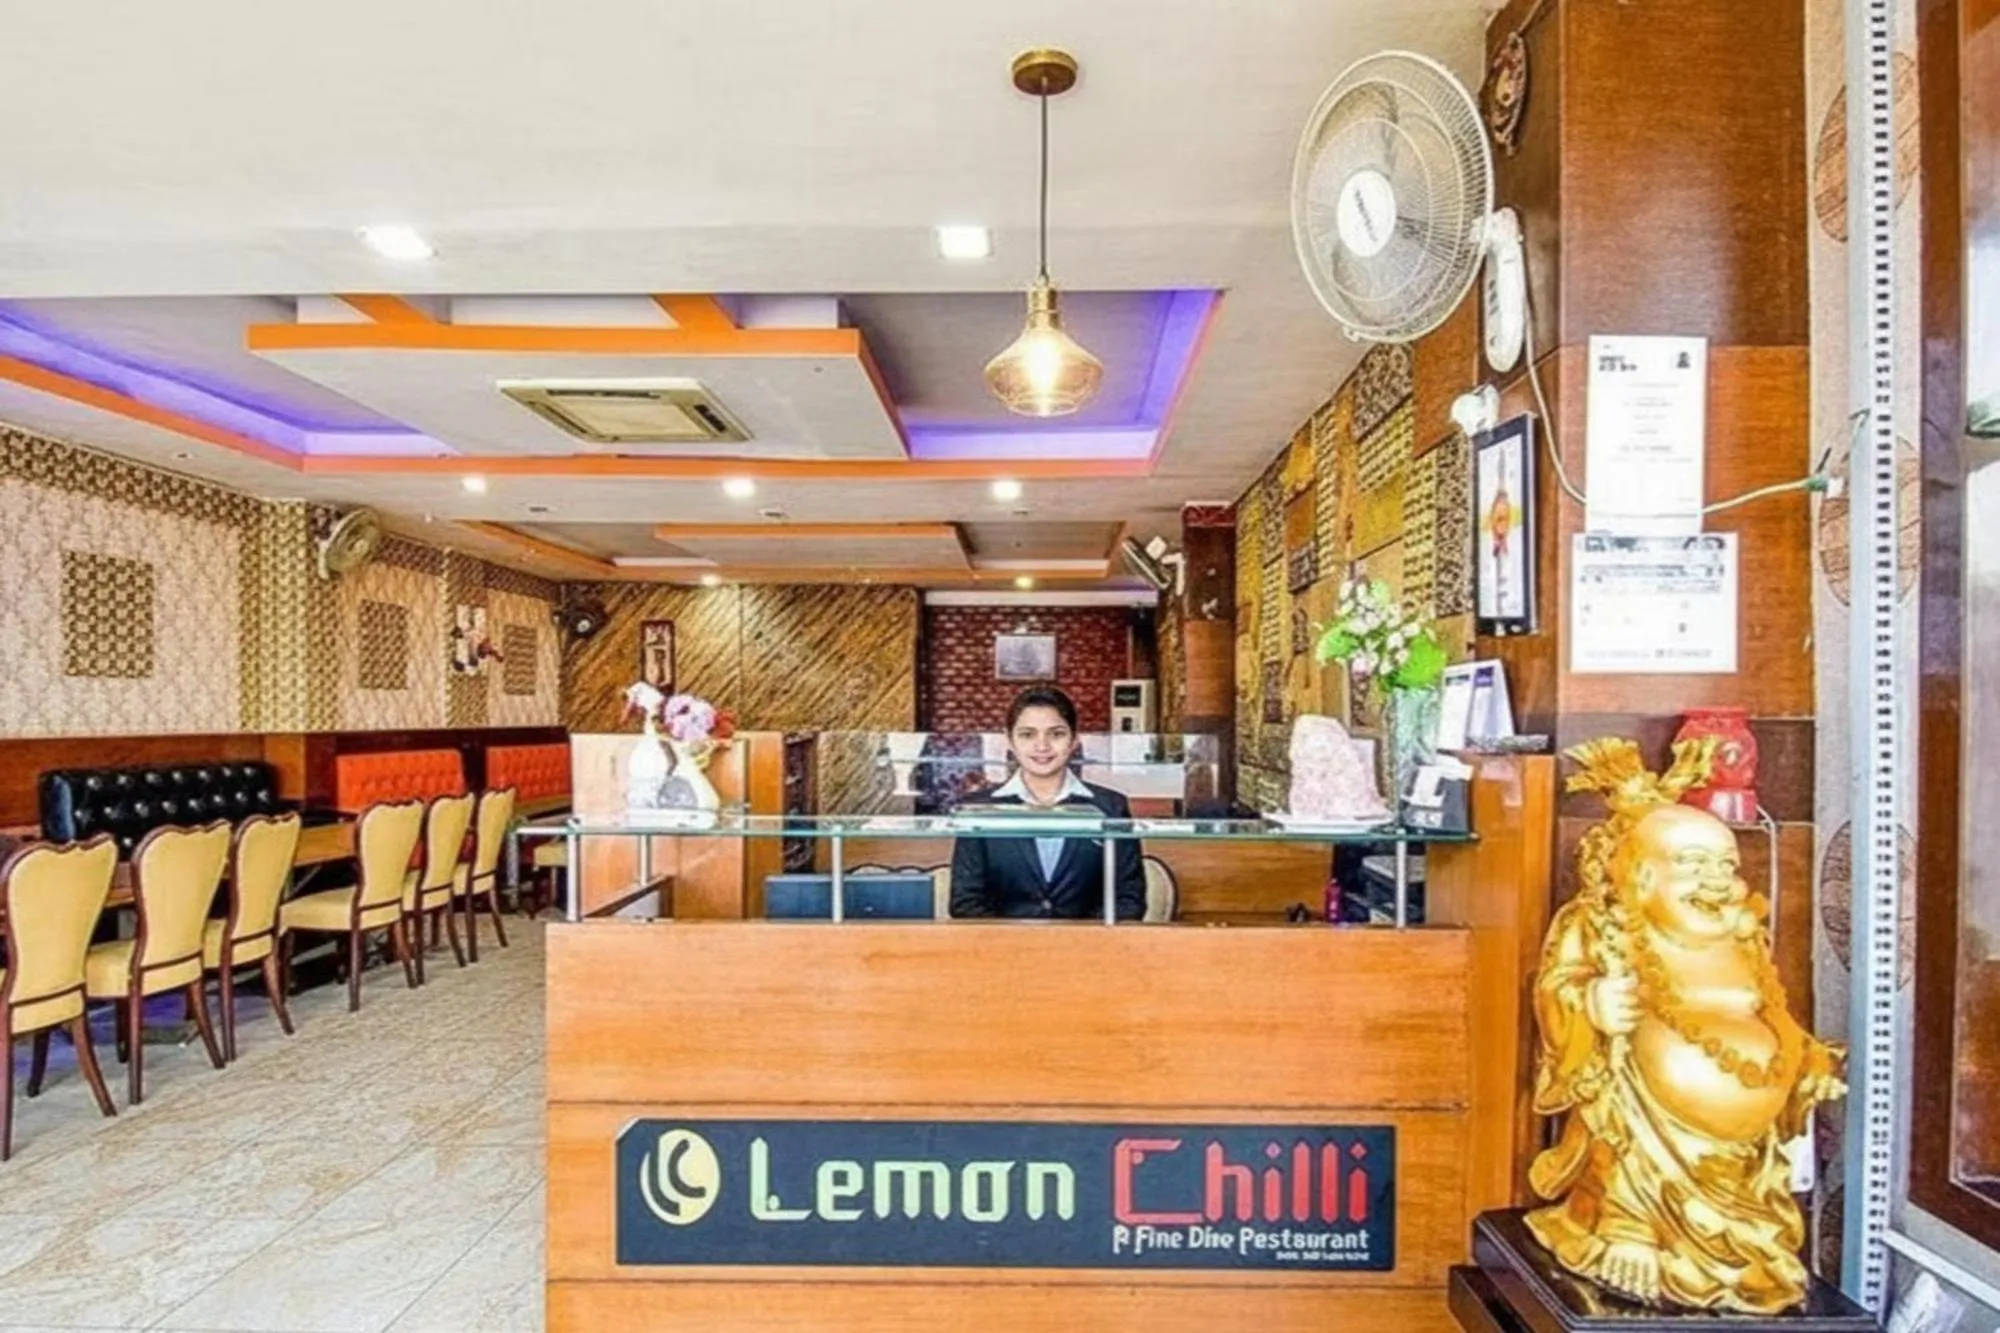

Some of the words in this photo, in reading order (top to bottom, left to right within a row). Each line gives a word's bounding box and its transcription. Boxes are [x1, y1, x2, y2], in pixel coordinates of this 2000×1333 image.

[750, 1136, 1076, 1223] Lemon
[1114, 1138, 1368, 1224] Chilli
[1133, 1224, 1184, 1255] Fine
